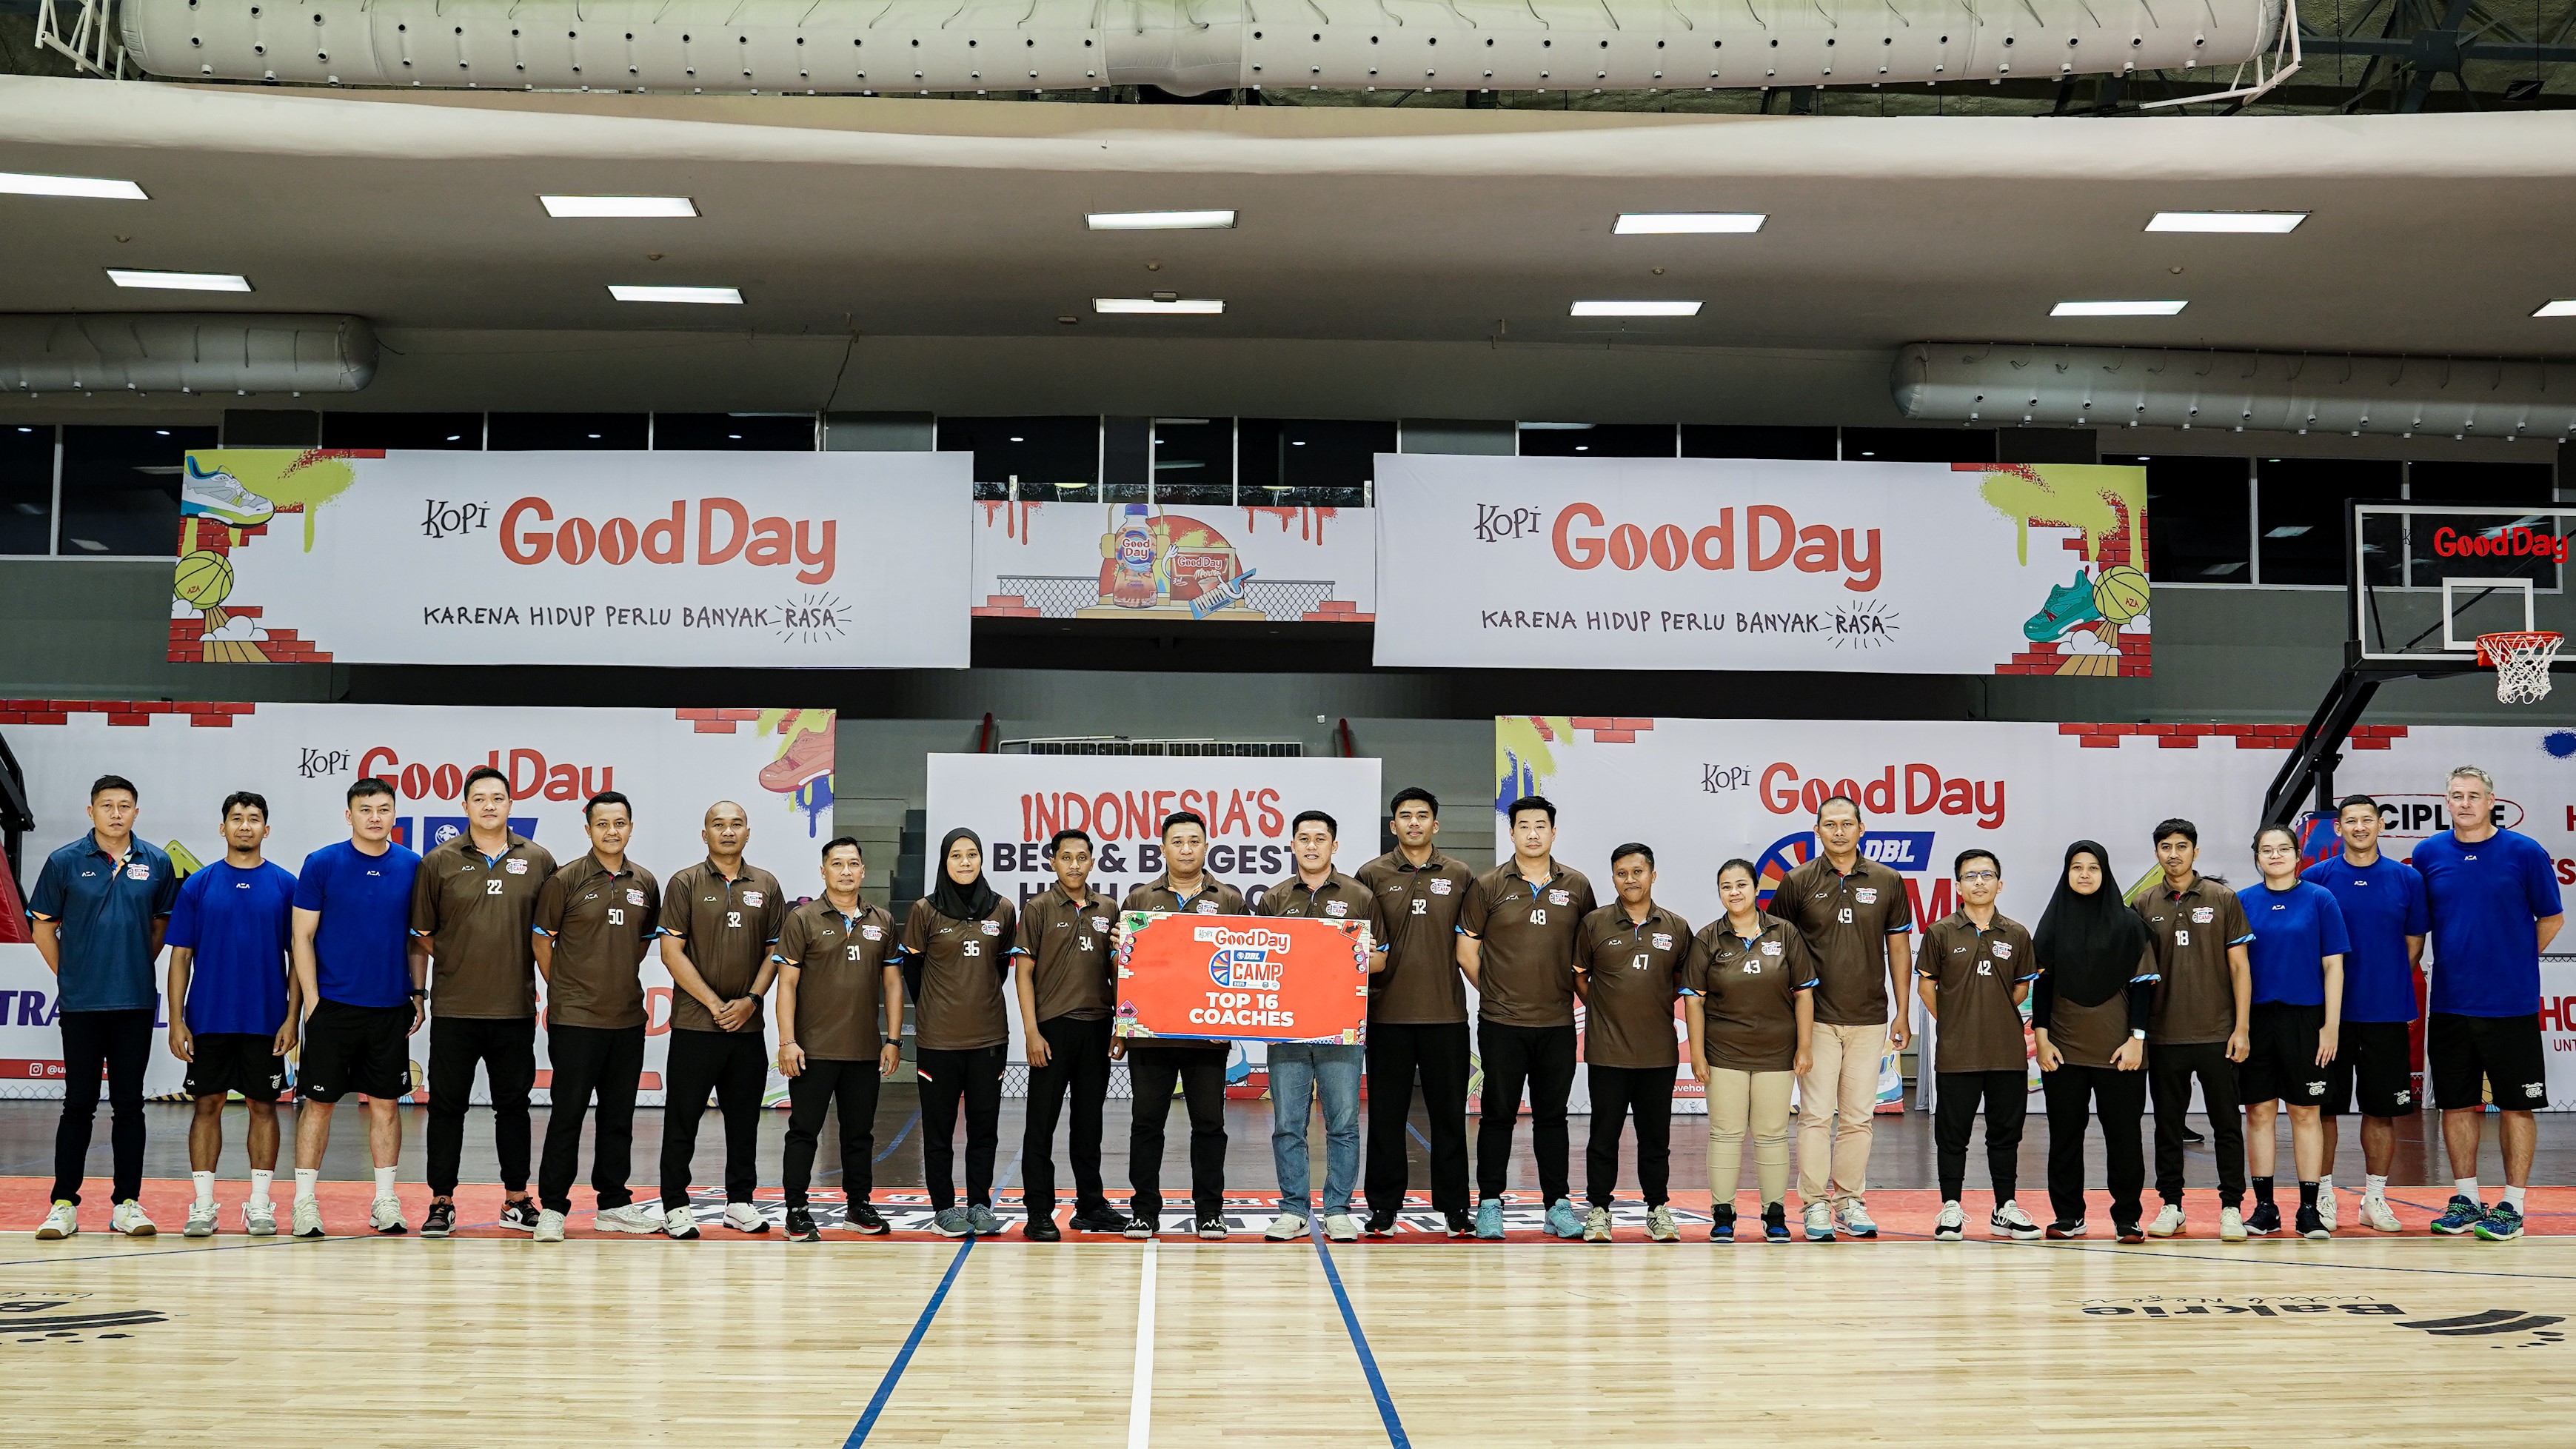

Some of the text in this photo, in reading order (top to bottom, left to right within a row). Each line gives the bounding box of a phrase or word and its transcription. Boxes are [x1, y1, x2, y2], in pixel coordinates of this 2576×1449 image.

[499, 496, 686, 565] Good
[697, 497, 837, 585] Day
[1123, 538, 1150, 549] Good
[1552, 502, 1735, 572] Good
[1747, 504, 1881, 592] Day
[2434, 526, 2509, 557] Good
[2512, 526, 2569, 563] Day
[1125, 547, 1149, 560] Day
[1178, 556, 1223, 569] Good Day
[424, 606, 837, 628] KARENA HIDUP PERLU BANYAK RASA
[1482, 610, 1885, 635] KARENA HIDUP PERLU BANYAK RASA
[1905, 763, 2005, 830] Day
[993, 843, 1055, 872] BES
[1098, 843, 1128, 873] &
[1864, 840, 1916, 863] DBL
[487, 880, 502, 894] 22
[1412, 899, 1426, 914] 52
[609, 908, 623, 925] 50
[727, 912, 741, 927] 32
[1530, 909, 1546, 925] 48
[1838, 908, 1852, 923] 49
[1080, 936, 1093, 951] 34
[1215, 930, 1255, 946] Good
[1257, 931, 1288, 951] Day
[2175, 931, 2189, 946] 18
[847, 946, 860, 960] 31
[964, 940, 980, 956] 36
[1633, 954, 1648, 970] 47
[1743, 960, 1761, 974] 43
[1977, 960, 1991, 975] 42
[1233, 963, 1281, 981] CAMP
[1205, 992, 1279, 1010] TOP 16
[1188, 1008, 1294, 1028] COACHES
[2081, 1302, 2408, 1318] Bakrie
